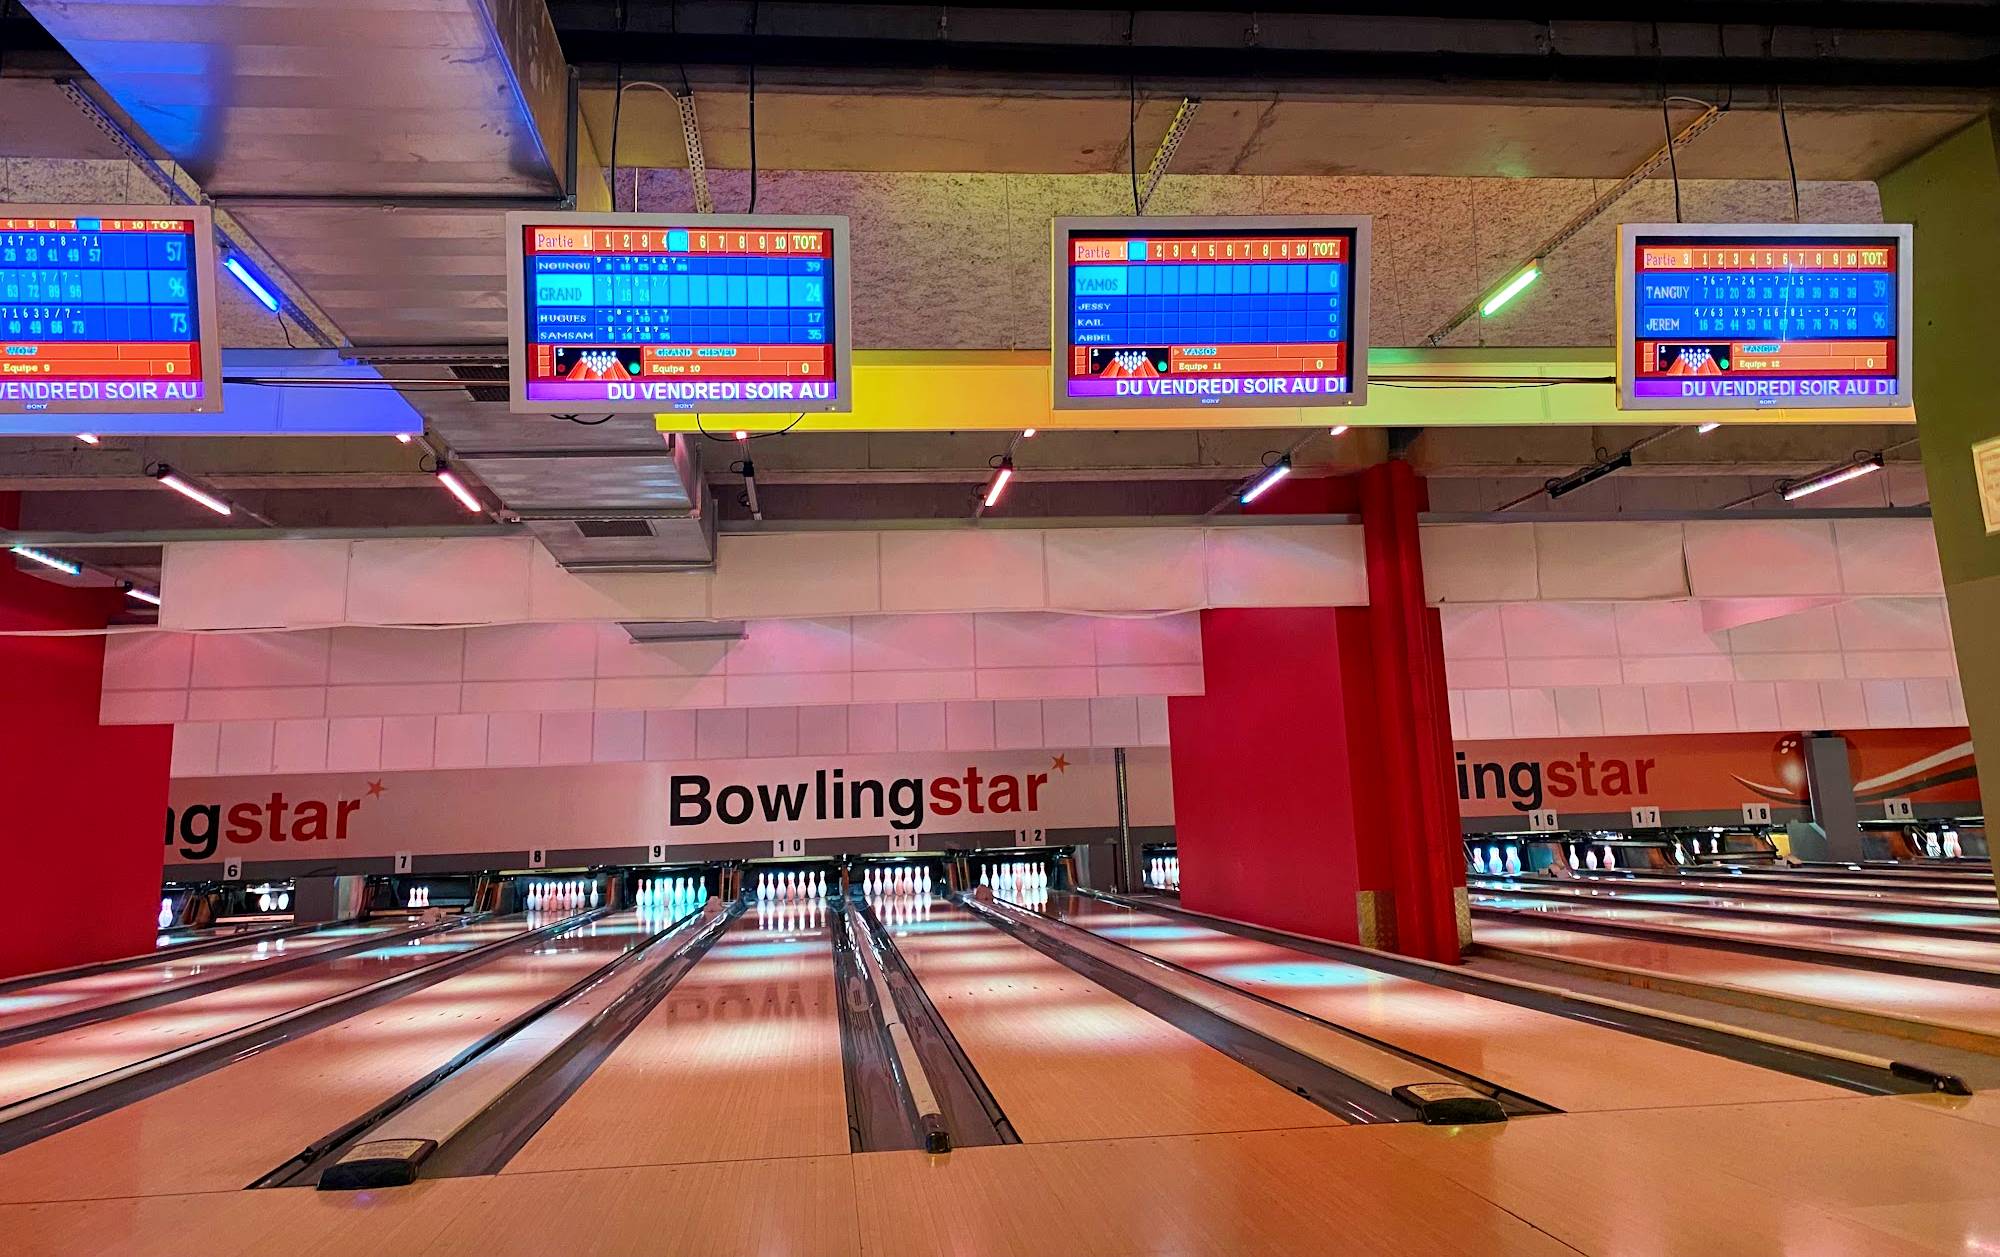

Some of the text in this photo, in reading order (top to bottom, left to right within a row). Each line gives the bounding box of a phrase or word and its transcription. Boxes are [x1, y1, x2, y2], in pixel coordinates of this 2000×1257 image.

[151, 221, 182, 230] TOT.
[538, 233, 574, 248] Partie
[776, 236, 786, 250] 10
[793, 236, 821, 250] TOT.
[166, 241, 182, 262] 57
[1078, 246, 1111, 258] Partie
[1296, 244, 1307, 256] 10
[1312, 242, 1339, 256] TOT.
[1646, 253, 1676, 266] Partie
[1847, 254, 1857, 265] 10
[1862, 252, 1886, 266] TOT.
[538, 262, 591, 270] NOUNOU
[806, 262, 821, 272] 39
[169, 277, 185, 298] 96
[1078, 278, 1119, 292] YAMOS
[1646, 286, 1690, 299] TANGUY
[1873, 280, 1886, 298] 39
[539, 288, 582, 302] GRAND
[806, 282, 821, 302] 24
[1078, 303, 1111, 311] JESSY
[170, 313, 187, 333] 73
[540, 315, 587, 323] HUGUES
[808, 312, 821, 323] 17
[1646, 318, 1680, 331] JEREM
[1873, 312, 1886, 329] 96
[540, 332, 594, 340] SAMSAM
[808, 329, 822, 340] 35
[656, 349, 693, 357] GRAND
[1183, 348, 1217, 356] YAMOS
[3, 363, 38, 373] Equipe
[653, 364, 684, 374] Equipe
[1179, 362, 1208, 371] Equipe
[1740, 360, 1767, 369] Equipe
[105, 382, 157, 399] SOIR
[164, 381, 197, 399] AU
[608, 382, 829, 400] DU VENDREDI SOIR AU
[1116, 378, 1346, 396] DU VENDREDI SOIR AU DI
[1682, 382, 1706, 396] DU
[1712, 381, 1795, 396] VENDREDI
[1800, 380, 1840, 395] SOIR
[1846, 380, 1869, 395] AU
[669, 766, 1049, 830] Bowlingstar
[1748, 808, 1767, 820] 18
[1888, 804, 1908, 815] 19
[1534, 814, 1554, 826] 16
[1637, 811, 1656, 823] 17
[895, 834, 915, 847] 11
[1020, 829, 1041, 842] 12
[653, 845, 661, 858] 9
[778, 839, 800, 853] 10
[400, 856, 407, 868] 7
[534, 850, 541, 863] 8
[228, 864, 238, 877] 6
